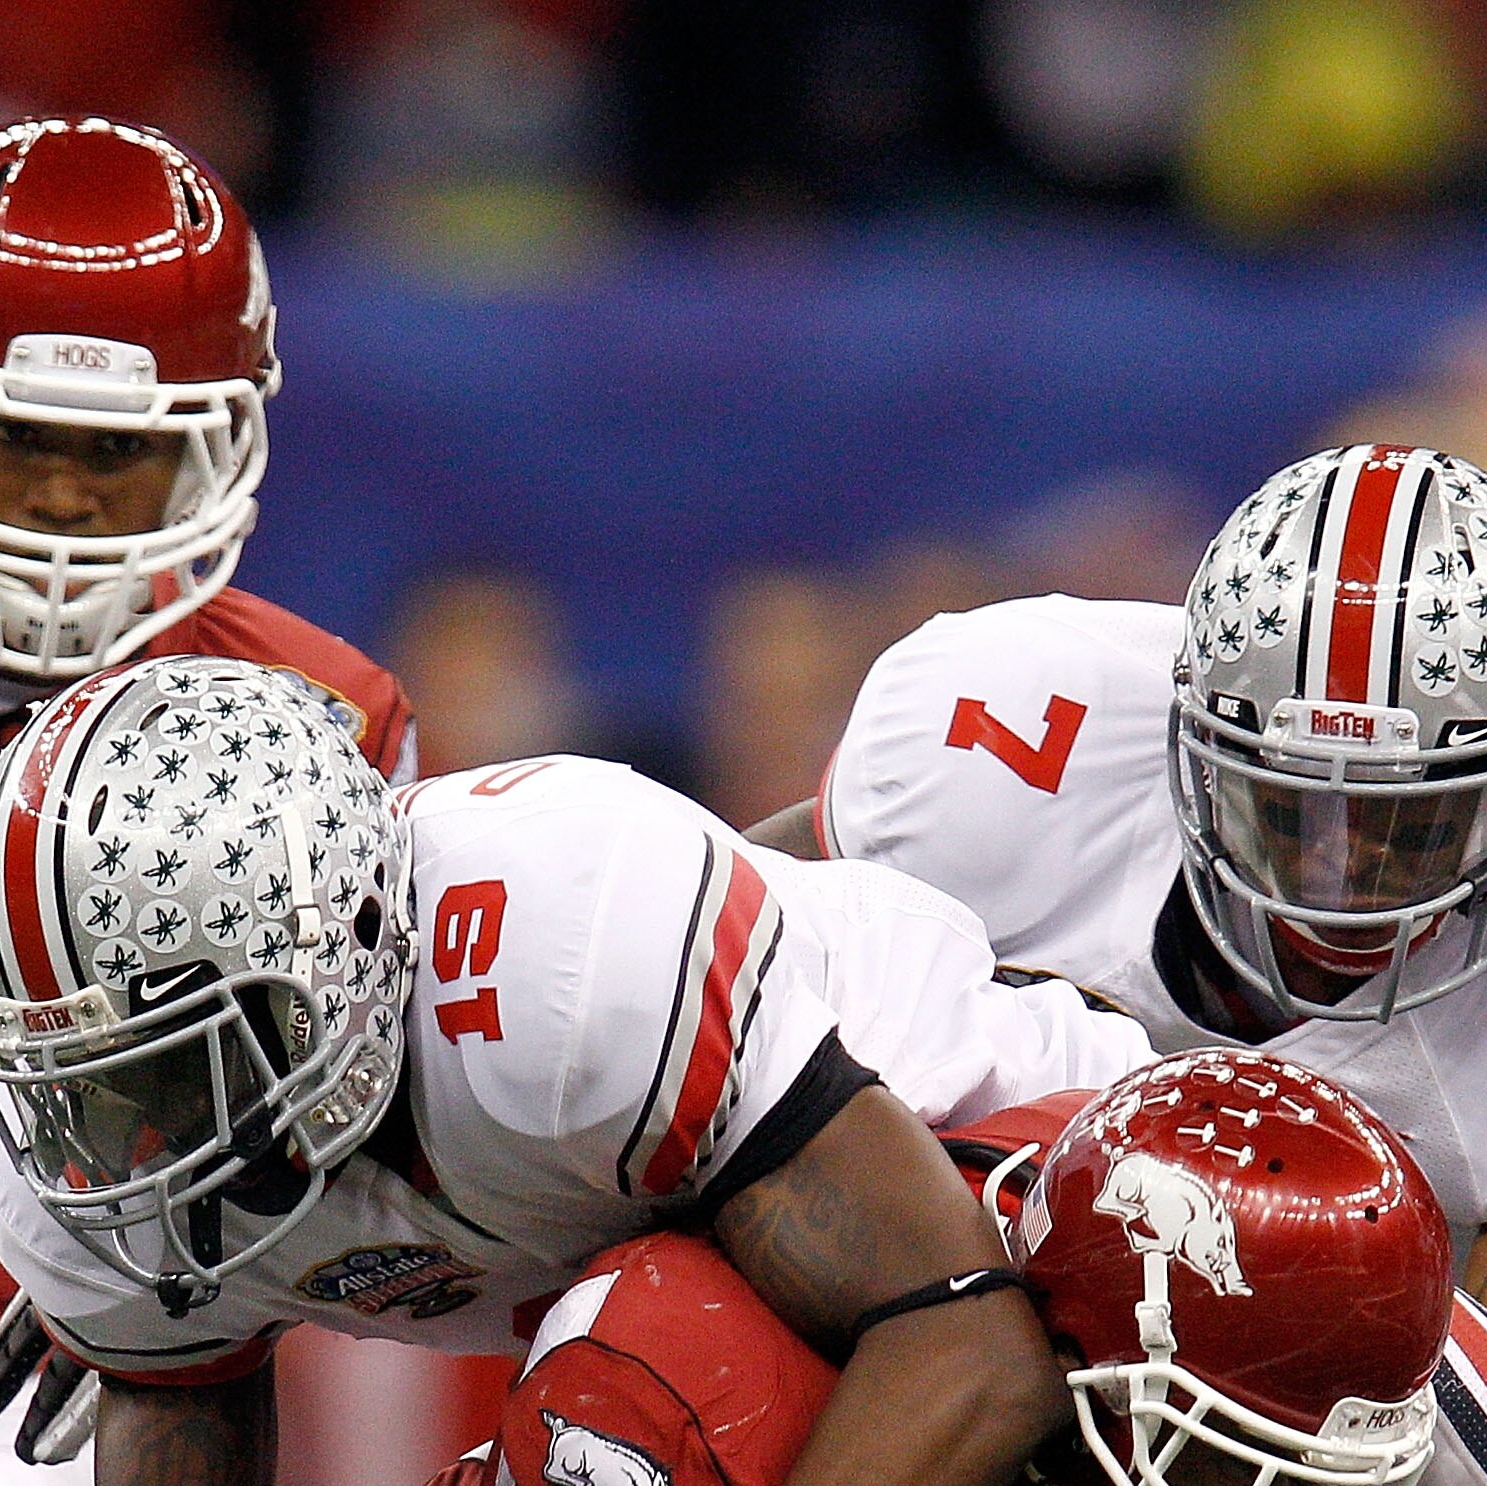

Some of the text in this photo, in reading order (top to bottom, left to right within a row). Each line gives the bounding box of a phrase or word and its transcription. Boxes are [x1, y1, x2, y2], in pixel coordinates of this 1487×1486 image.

[55, 342, 112, 369] HOGS
[944, 693, 1088, 795] 7
[431, 878, 508, 1046] 19
[337, 1253, 431, 1297] Allstate
